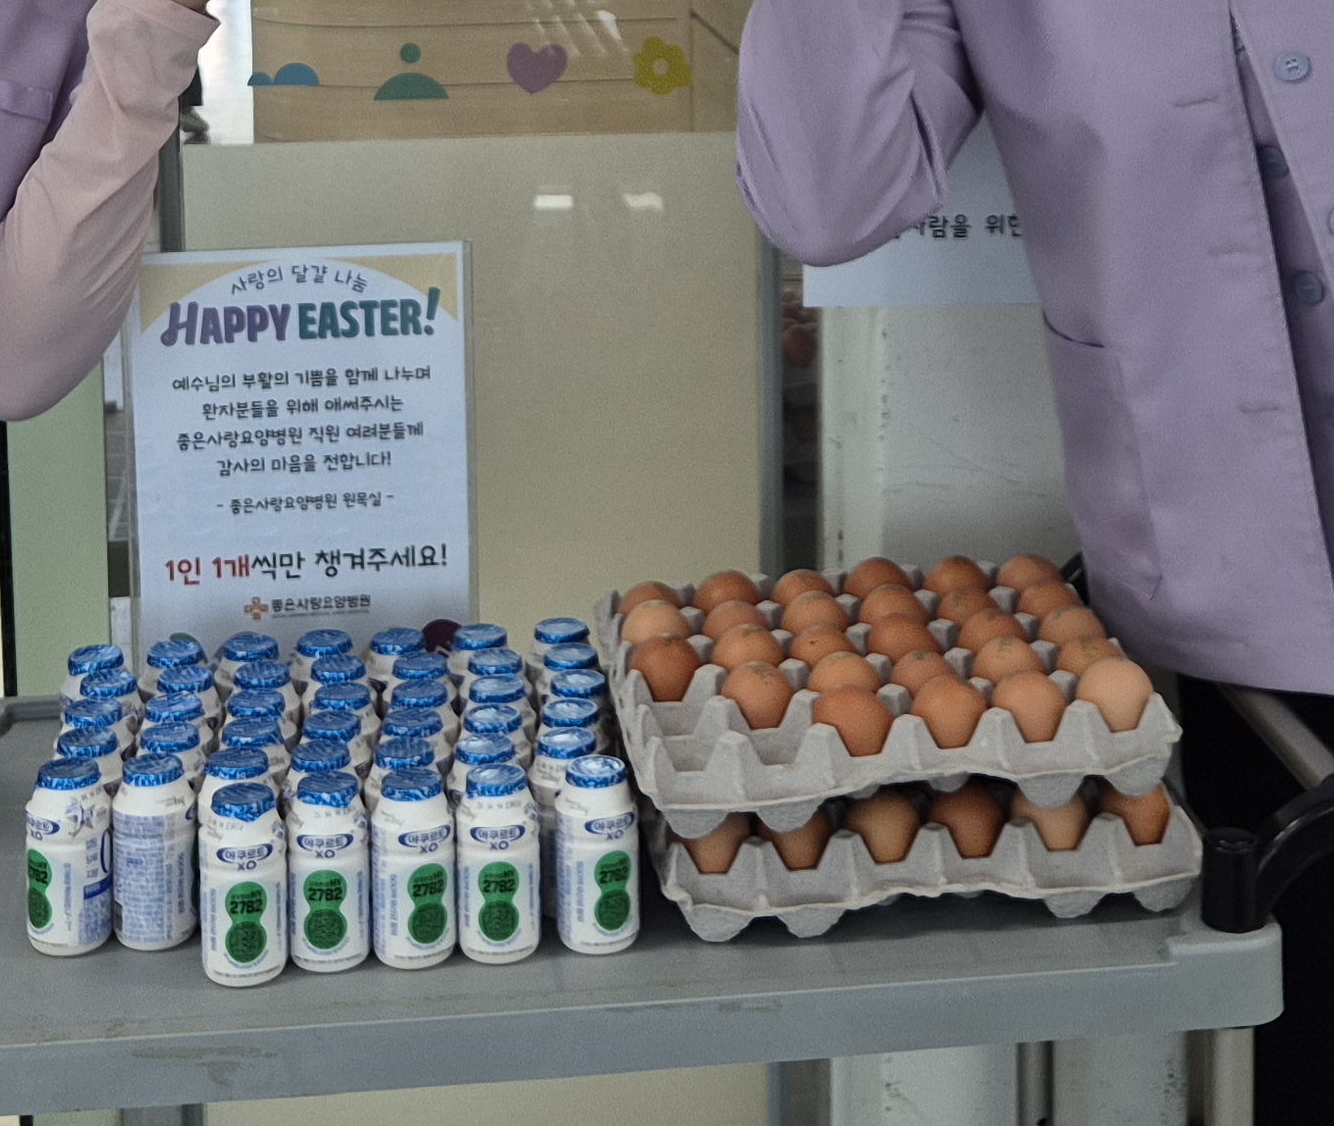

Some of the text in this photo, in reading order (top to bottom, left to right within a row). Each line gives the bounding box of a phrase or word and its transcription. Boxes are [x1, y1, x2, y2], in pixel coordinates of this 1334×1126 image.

[231, 264, 368, 295] 사랑의 달걀 나눔
[160, 286, 441, 346] HAPPY EASTER!
[172, 365, 431, 393] 예수님의 부활의 기쁨을 함께 나누며
[202, 395, 404, 421] 환자분들을 위해 애써주시는
[177, 422, 424, 451] 좋은사랑요양병원 직원 여러분들께
[216, 451, 391, 477] 감사의 마음을 전합니다!
[230, 493, 337, 514] 좋은사랑요양병원
[343, 491, 382, 508] 원목실
[165, 543, 447, 585] 1인 1개씩만 챙겨주세요!
[606, 829, 624, 841] XO
[315, 849, 336, 859] XO
[419, 841, 439, 854] XO
[489, 840, 510, 851] XO
[237, 859, 257, 871] XO
[308, 886, 343, 902] 2782
[412, 879, 445, 898] 2782
[483, 879, 516, 893] 2782
[230, 898, 264, 915] 2782
